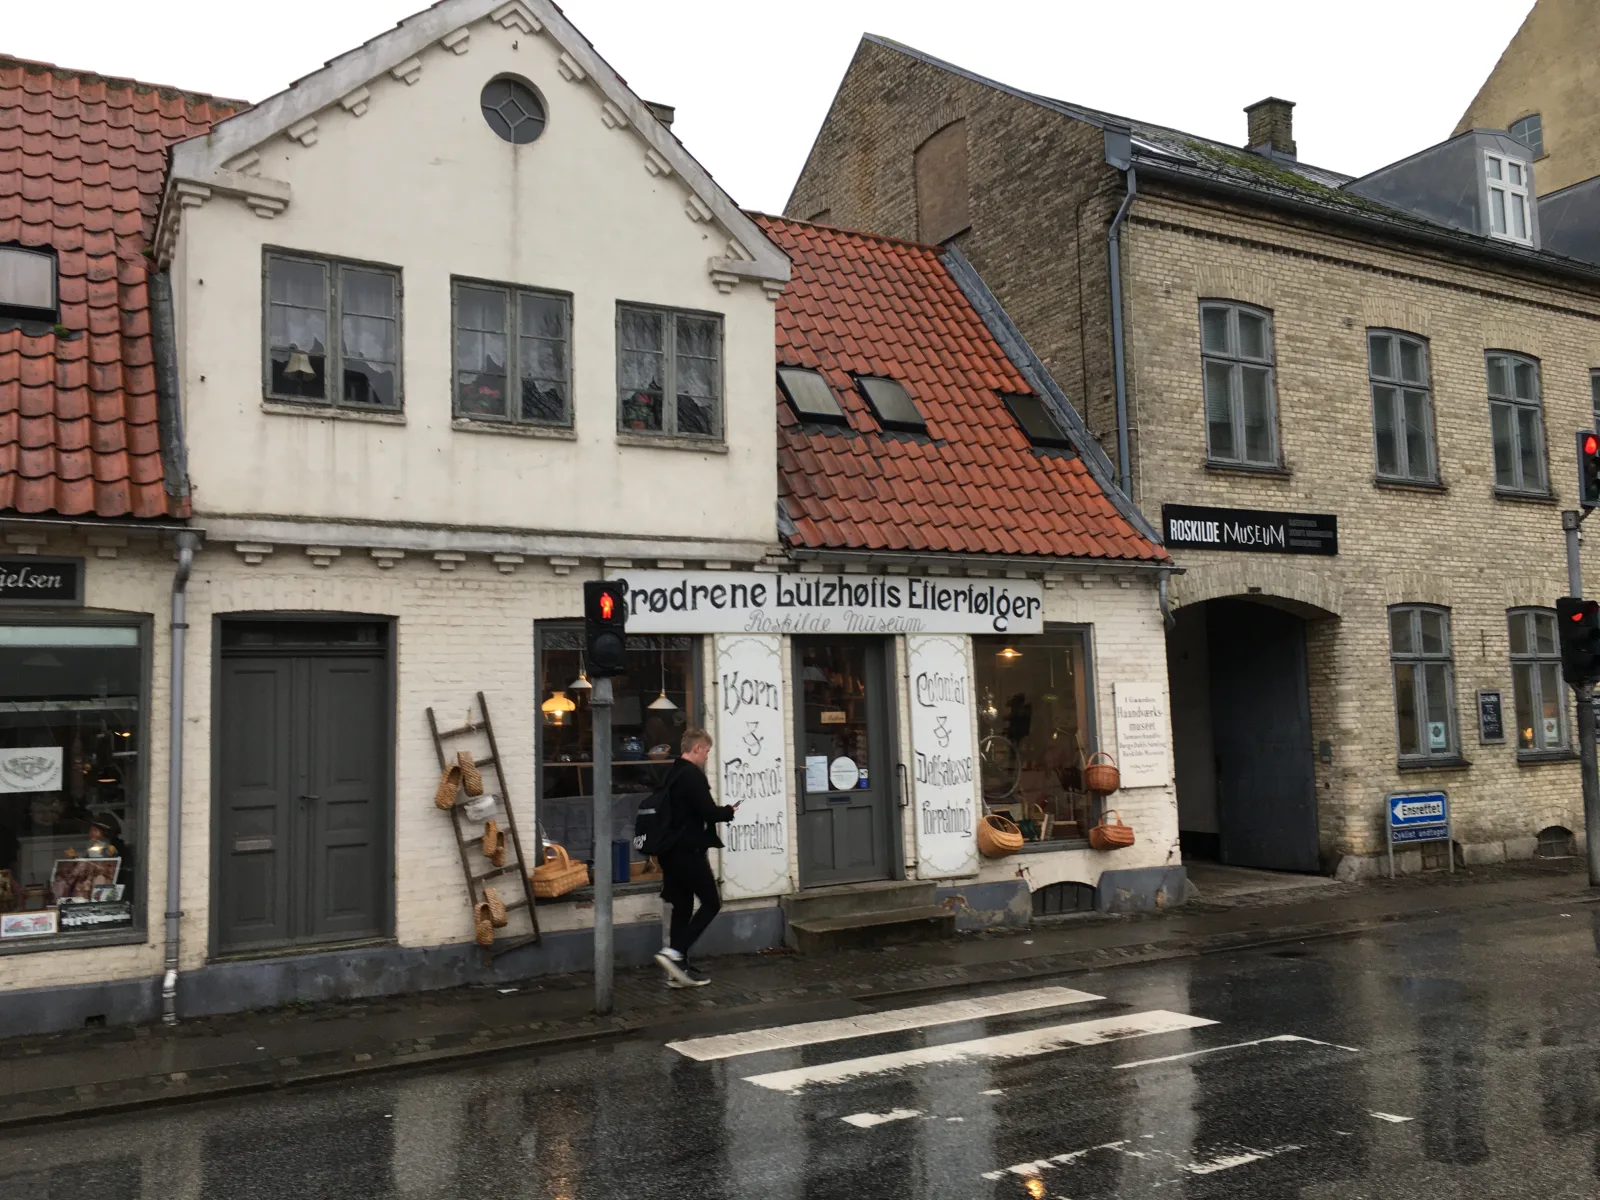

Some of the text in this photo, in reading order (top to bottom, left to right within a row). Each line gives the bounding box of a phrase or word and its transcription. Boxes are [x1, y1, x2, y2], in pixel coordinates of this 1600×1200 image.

[1170, 518, 1285, 548] ROSKILDE MUSEUM
[744, 608, 832, 633] Roskilde
[908, 577, 1041, 632] Efterfølger
[721, 670, 779, 716] Korn
[915, 671, 966, 709] Colonial
[1401, 803, 1441, 816] Ensrettet
